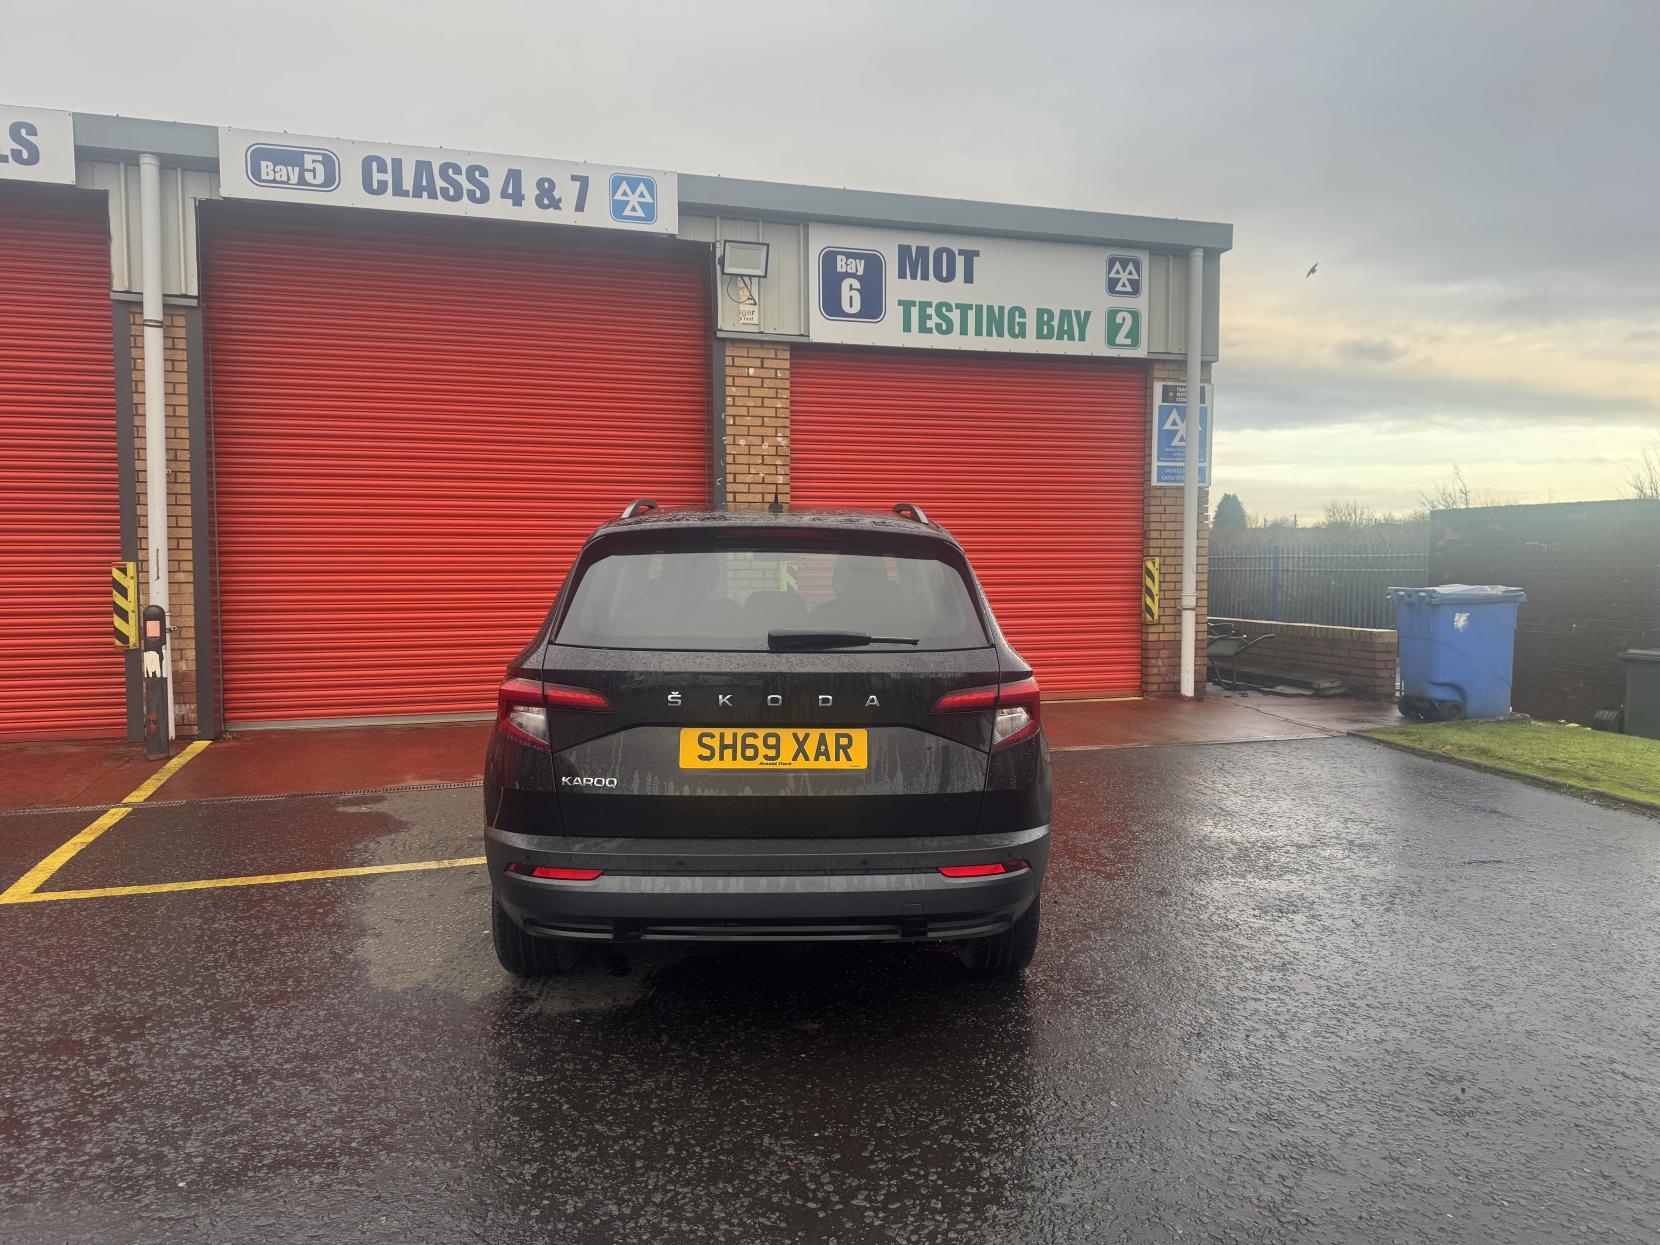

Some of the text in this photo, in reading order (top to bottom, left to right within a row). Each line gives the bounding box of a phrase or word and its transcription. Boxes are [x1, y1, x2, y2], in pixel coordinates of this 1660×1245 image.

[260, 153, 325, 185] Bay 5
[361, 154, 590, 213] CLASS 4 & 7
[836, 254, 865, 276] Bay
[897, 243, 980, 285] MOT
[840, 277, 861, 314] 6
[897, 299, 1092, 343] TESTING BAY
[1115, 311, 1133, 345] 2
[697, 732, 853, 762] SH69 XAR
[561, 776, 617, 789] KAROQ
